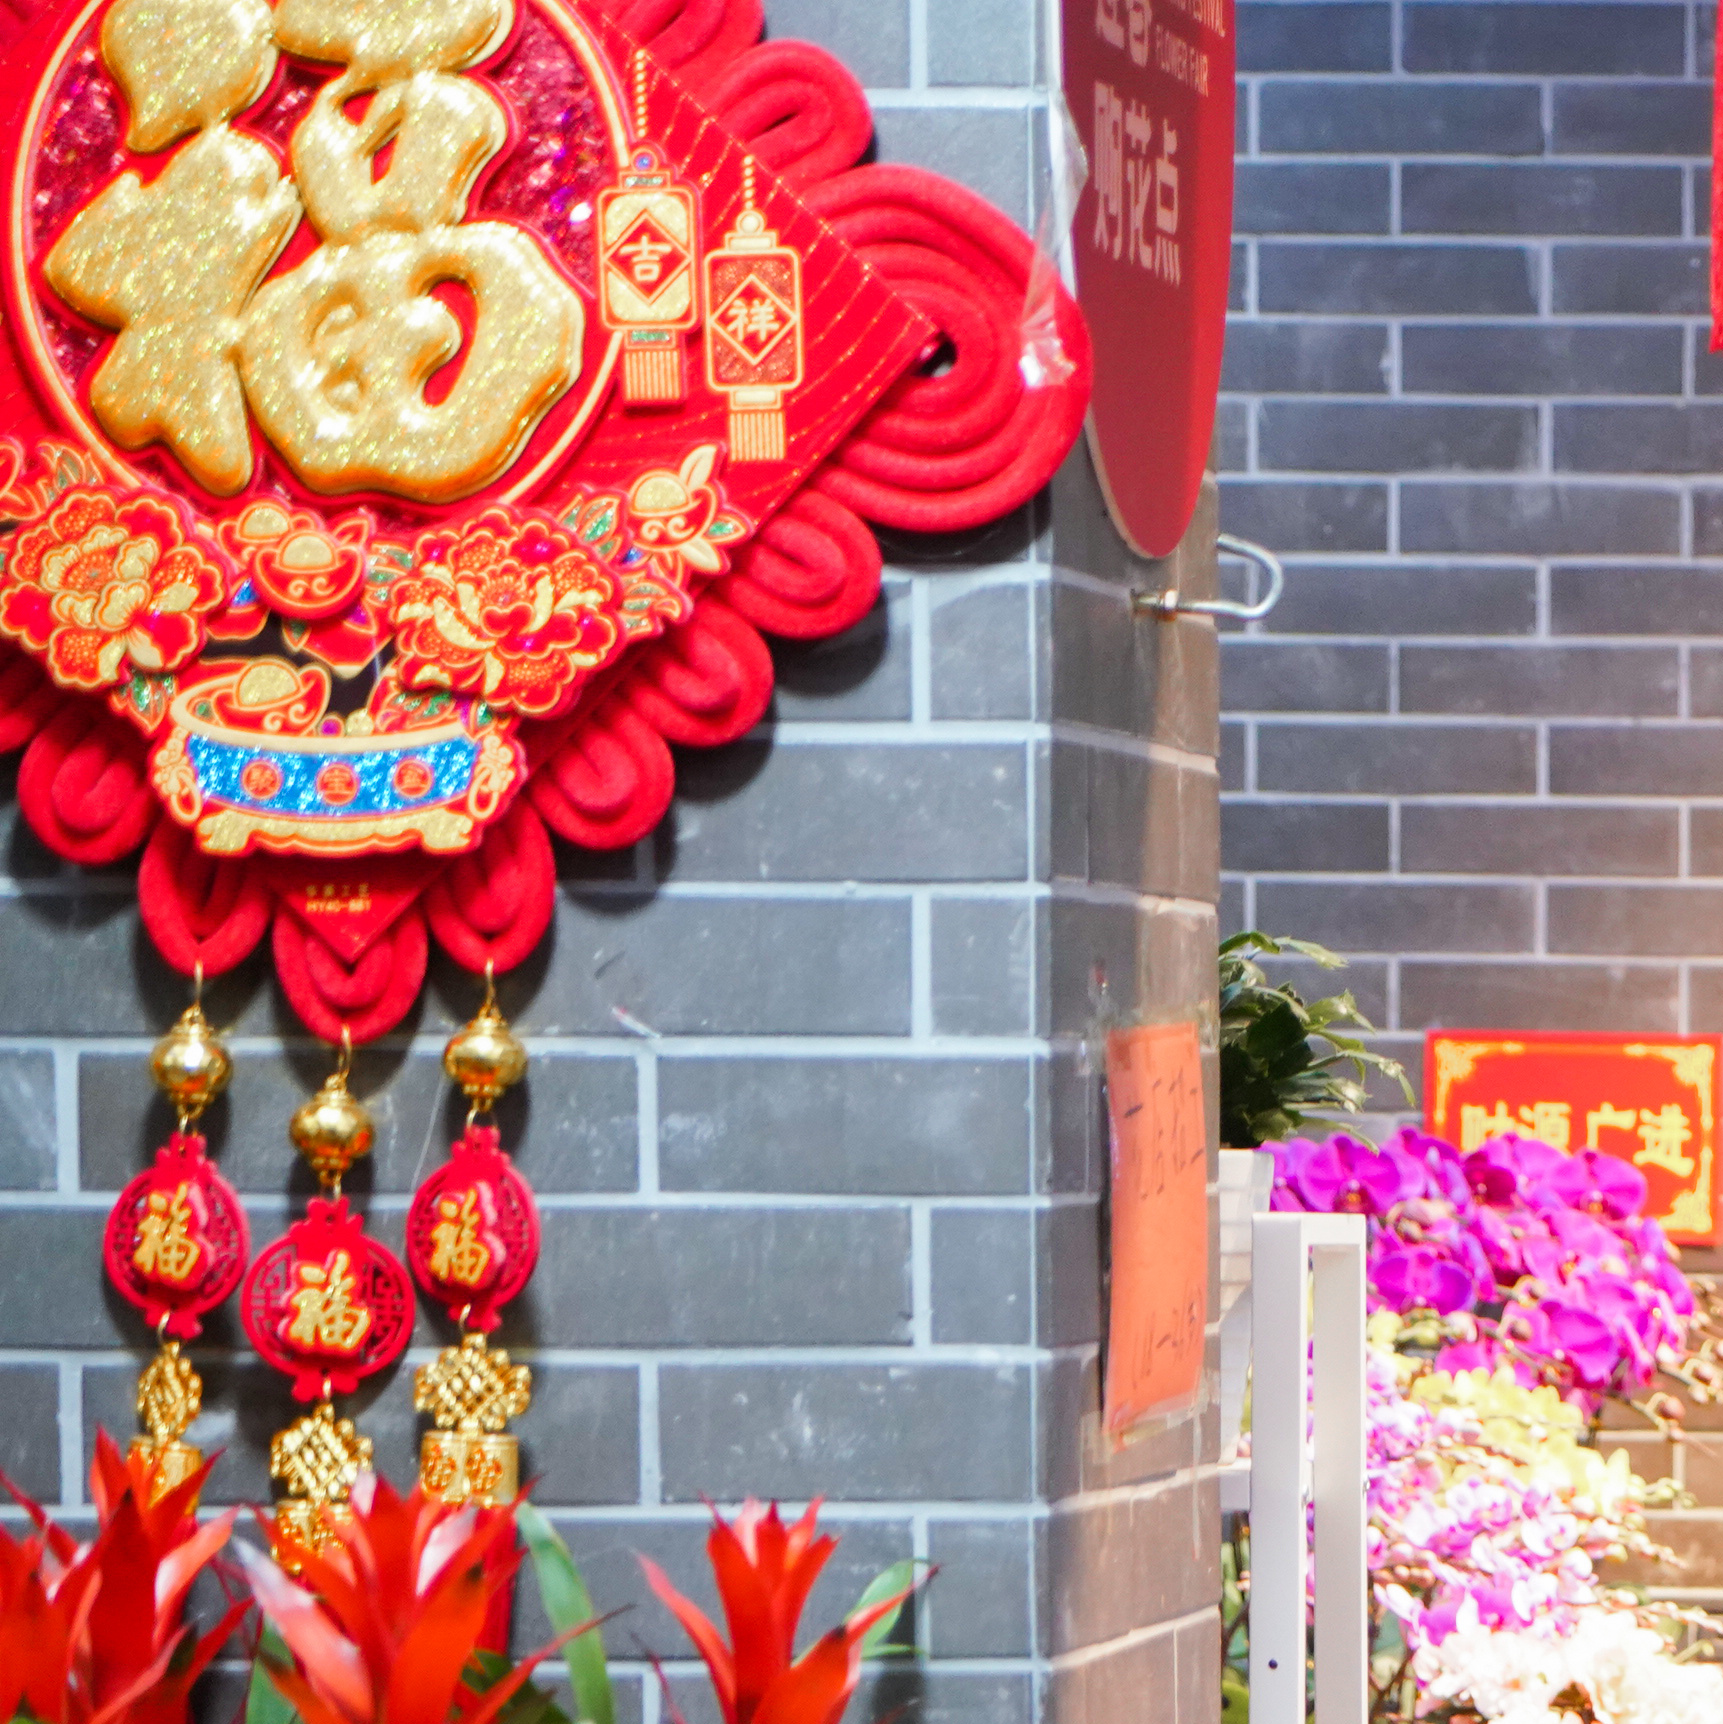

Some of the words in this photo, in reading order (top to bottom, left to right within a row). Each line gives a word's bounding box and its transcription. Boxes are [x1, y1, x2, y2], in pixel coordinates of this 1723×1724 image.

[1093, 79, 1181, 288] 购花点
[43, 0, 586, 500] 福
[619, 234, 673, 283] 吉
[726, 298, 781, 342] 祥
[132, 1182, 202, 1282] 福
[429, 1188, 491, 1286] 福
[289, 1249, 373, 1350] 福
